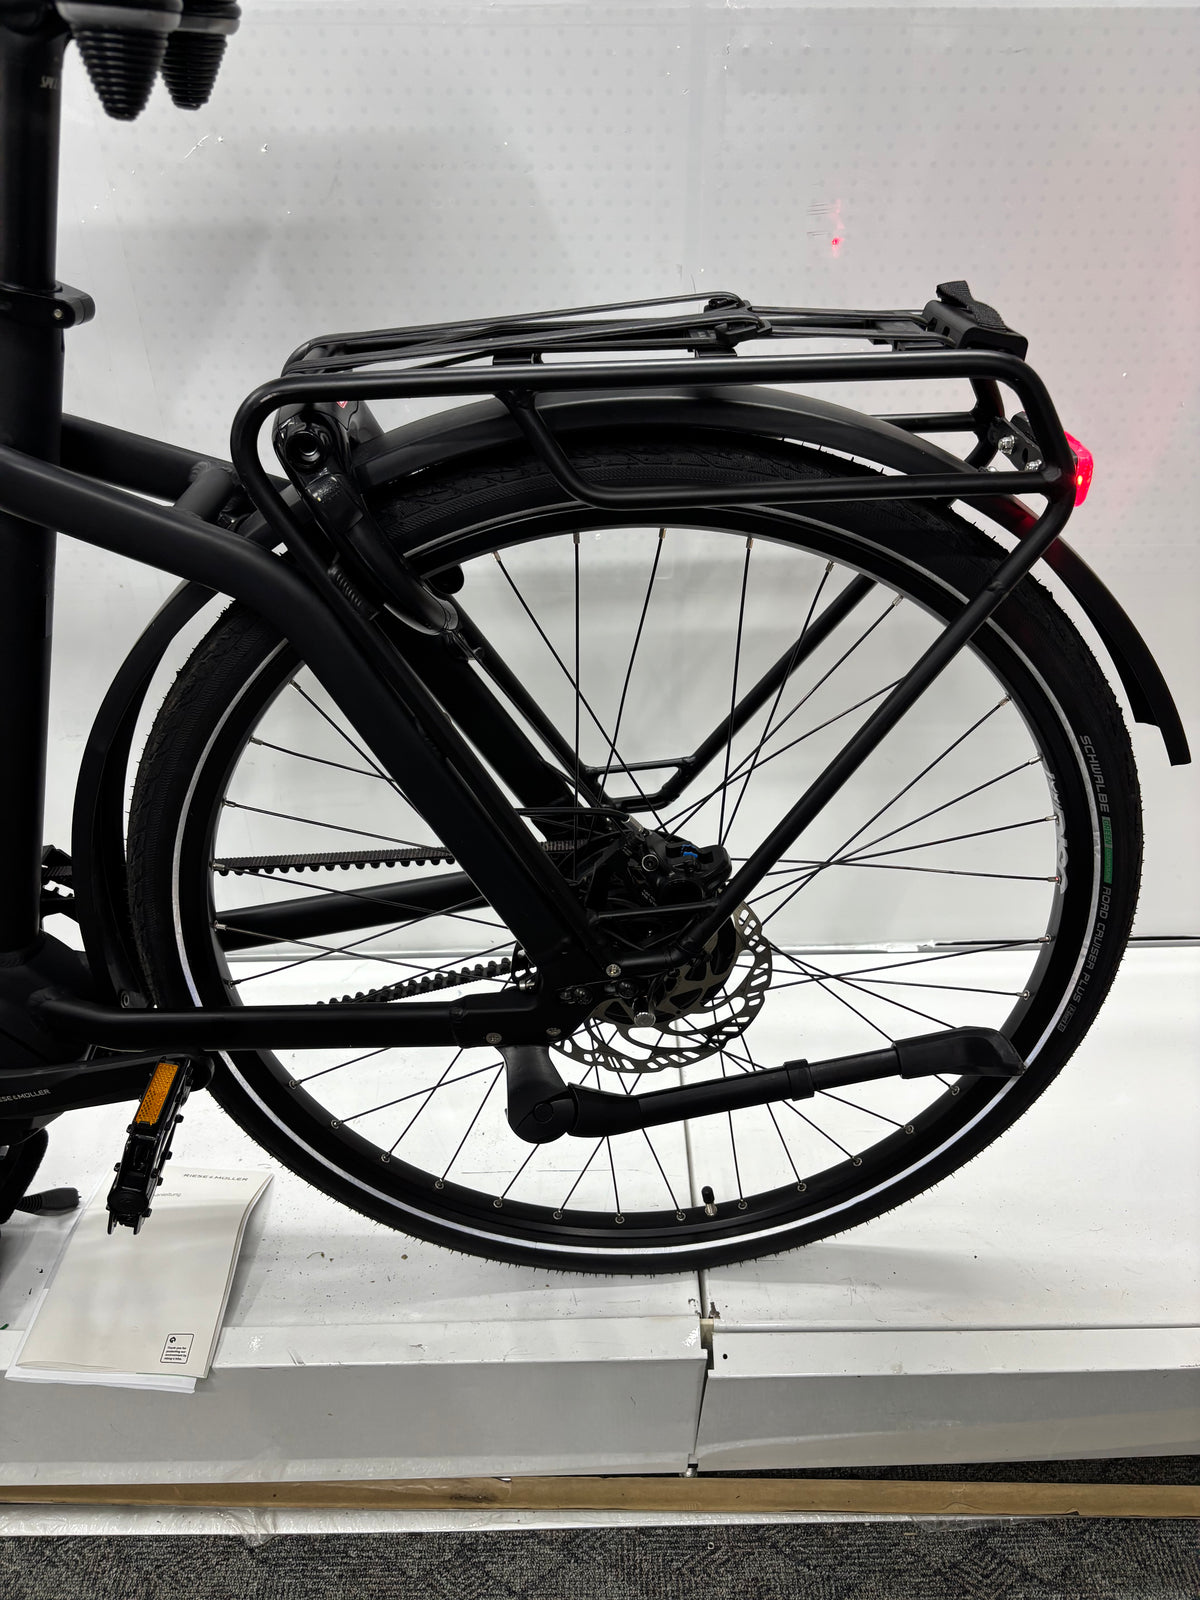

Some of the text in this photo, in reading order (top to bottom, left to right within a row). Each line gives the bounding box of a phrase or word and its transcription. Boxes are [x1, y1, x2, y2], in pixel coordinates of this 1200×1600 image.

[1080, 735, 1110, 813] SCHWALBE
[1100, 886, 1112, 920] ROAD
[1086, 922, 1106, 970] CRUISER
[1073, 973, 1091, 1004] PLUS
